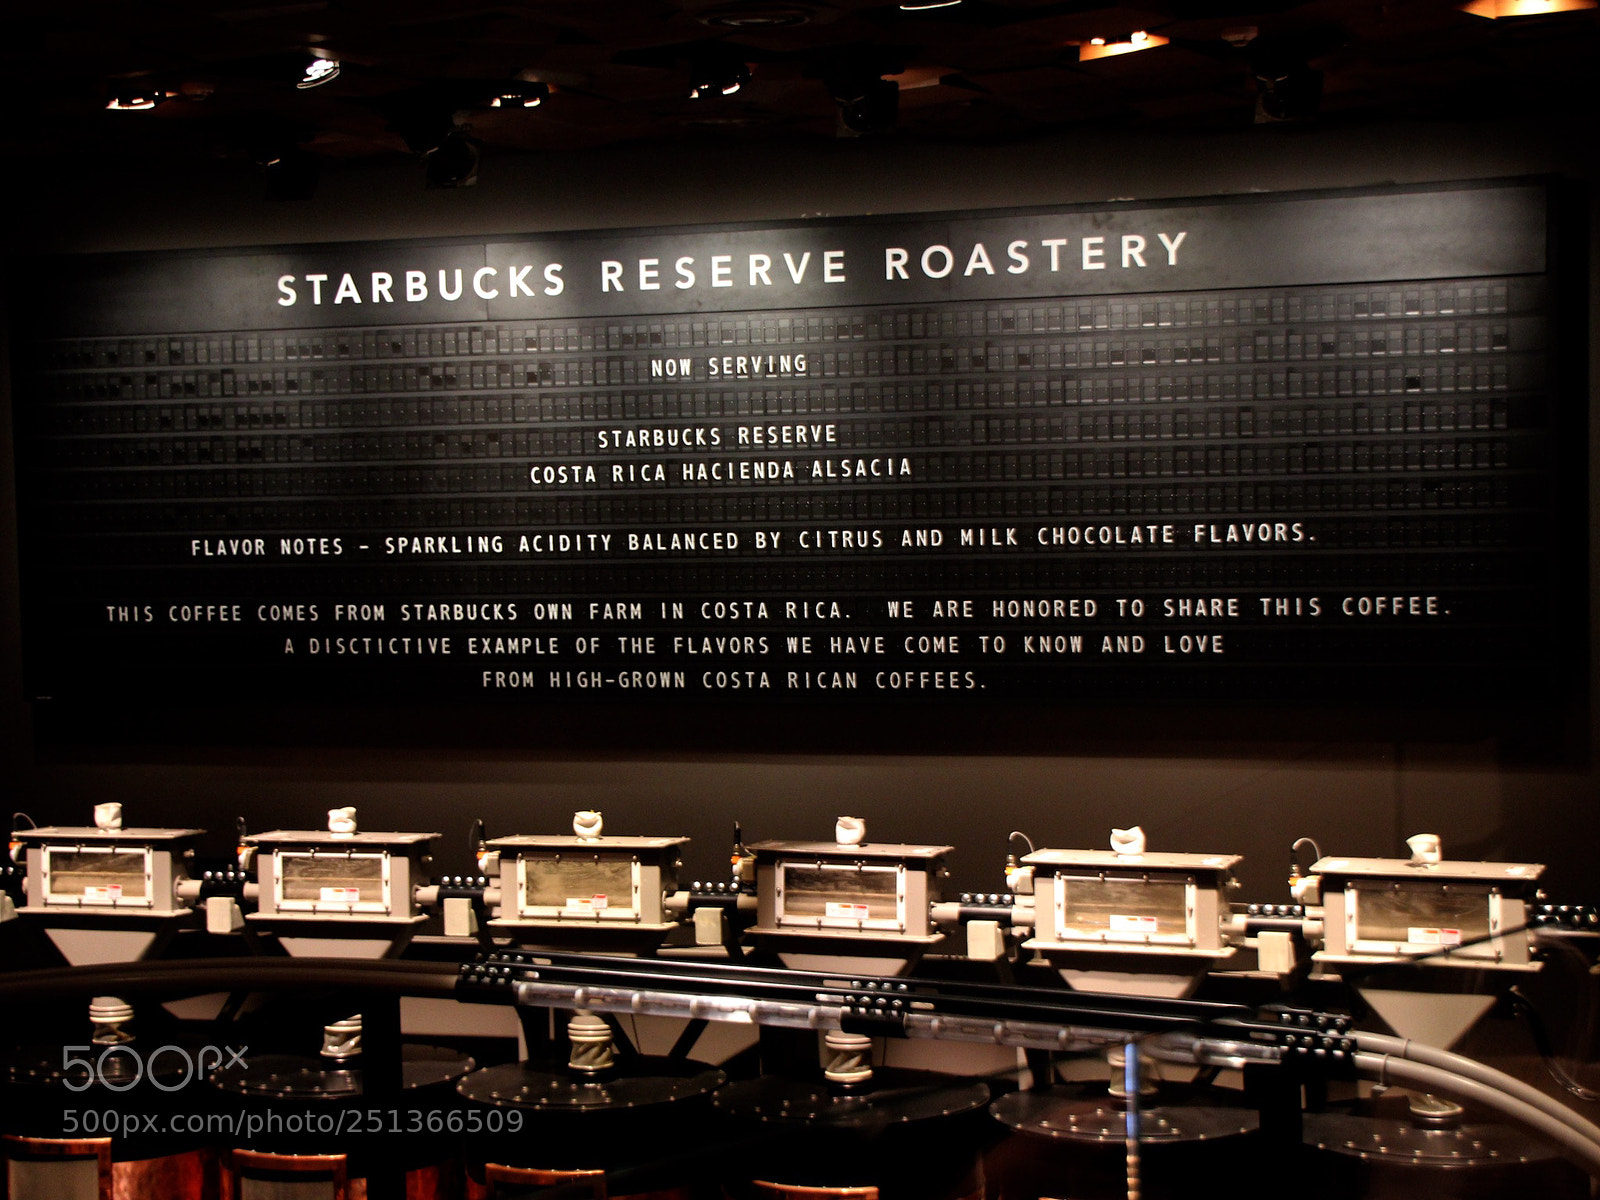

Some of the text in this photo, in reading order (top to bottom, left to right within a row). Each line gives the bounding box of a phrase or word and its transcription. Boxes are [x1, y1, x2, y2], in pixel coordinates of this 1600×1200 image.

[277, 231, 1188, 308] STARBUCKS RESERVE ROASTERY
[651, 353, 807, 377] NOW SERVING
[597, 424, 837, 449] STARBUCKS RESERVE
[530, 457, 911, 485] COSTA RICA HACIENDA ALSACIA
[191, 538, 265, 556] FLAVOR
[280, 537, 343, 555] NOTES
[385, 535, 503, 555] SPARKLING
[518, 533, 612, 553] ACIDITY
[628, 532, 739, 551] BALANCED
[755, 531, 781, 549] BY
[799, 529, 883, 549] CITRUS
[901, 529, 944, 547] AND
[960, 527, 1018, 546] MILK
[1037, 524, 1175, 546] CHOCOLATE
[1194, 522, 1315, 543] FLAVORS.
[106, 596, 1450, 623] THIS COFFEE COMES FROM STARBUCKS OWN FARM IN COSTA RICA. WE ARE HONORED TO SHARE THIS COFFEE.
[284, 634, 1224, 655] A DISCTICTIVE EXAMPLE OF THE FLAVORS WE HAVE COME TO KNOW AND LOVE
[482, 670, 986, 689] FROM HIGH-GROWN COSTA RICAN COFFEES.
